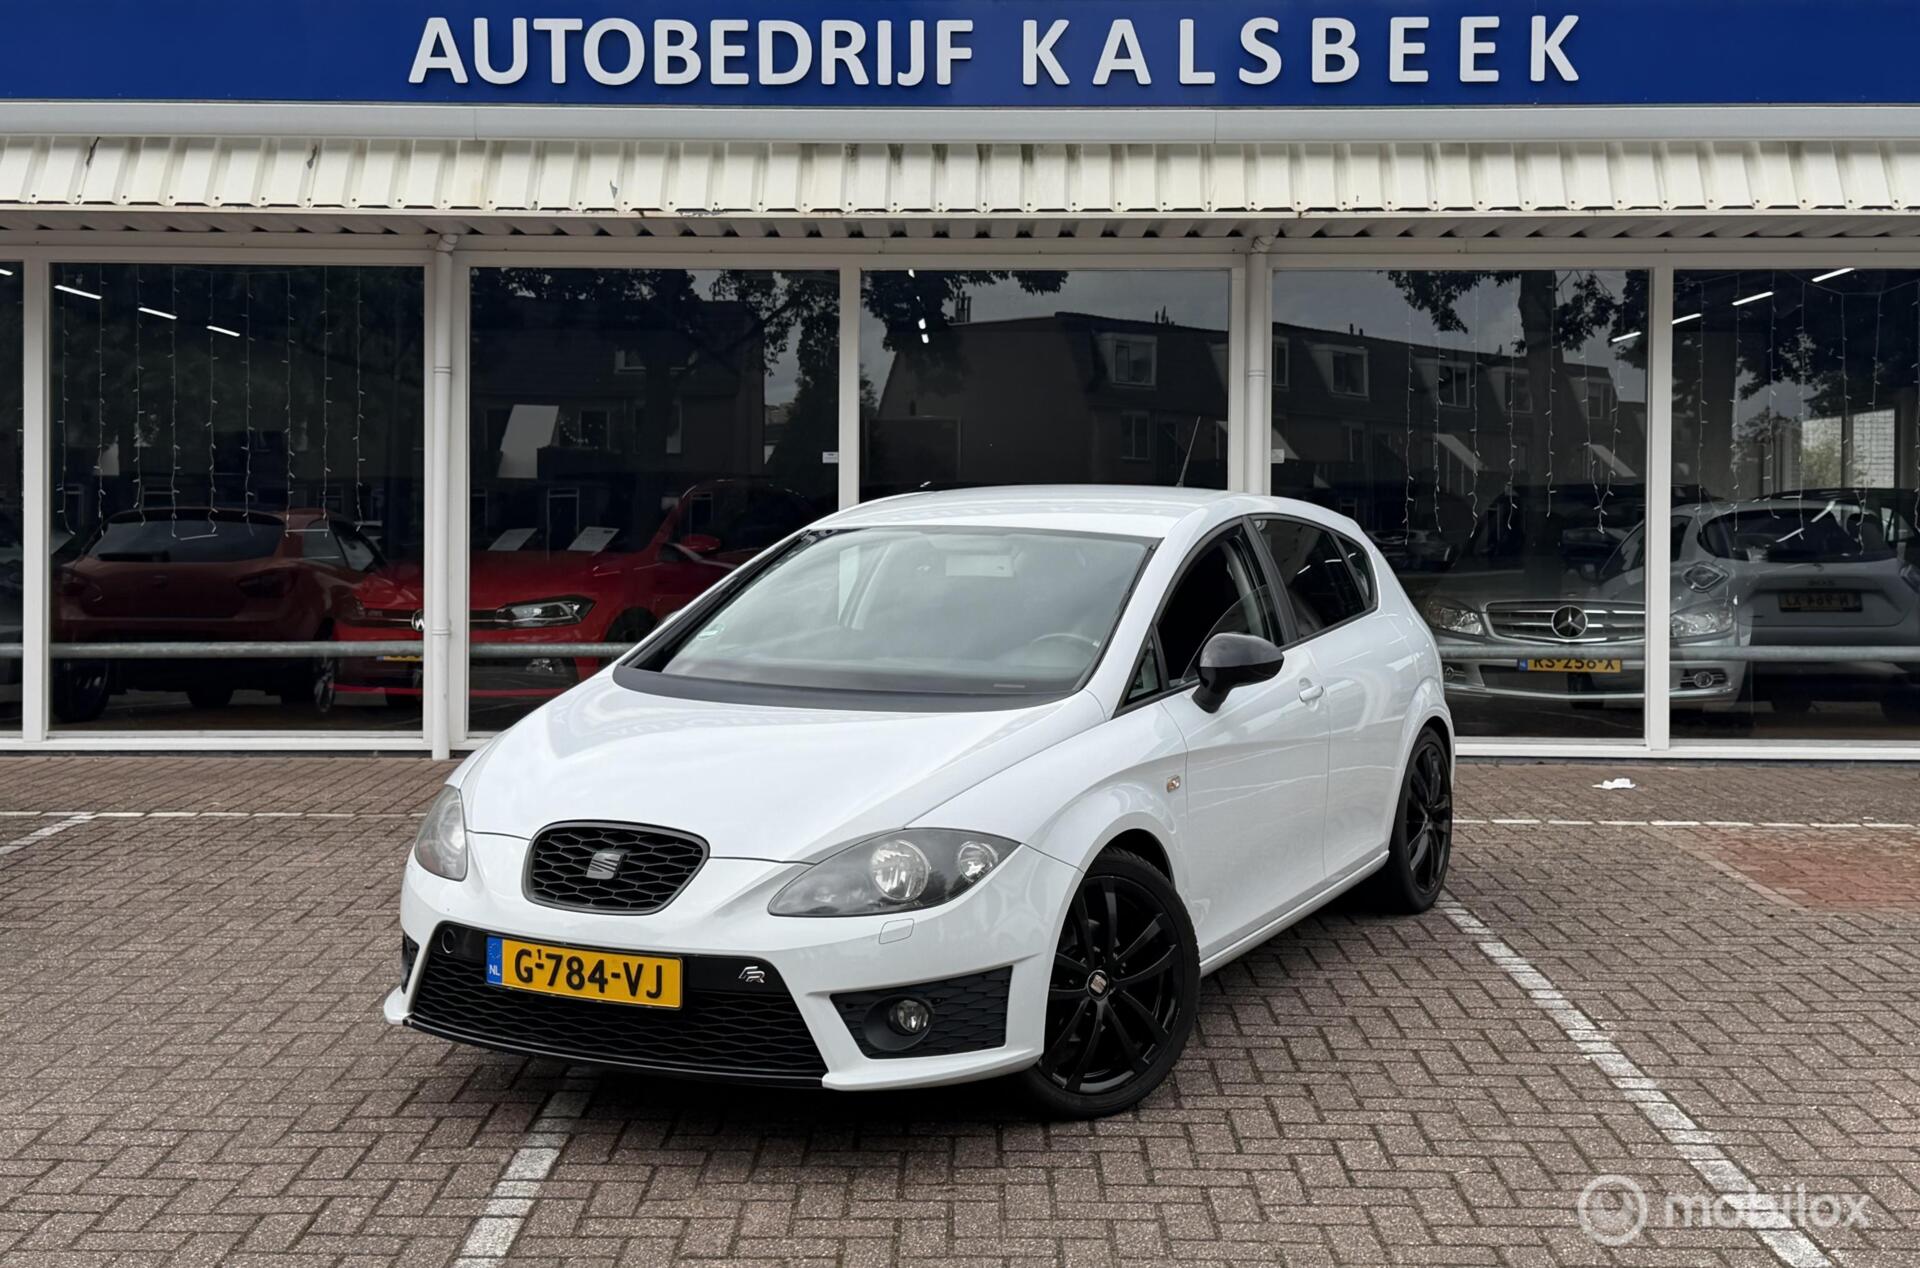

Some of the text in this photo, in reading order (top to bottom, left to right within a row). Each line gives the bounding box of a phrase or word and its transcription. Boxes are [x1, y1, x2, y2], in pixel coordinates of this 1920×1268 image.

[408, 15, 1580, 86] AUTOBEDRIJF KALSBEEK
[489, 963, 501, 977] NL
